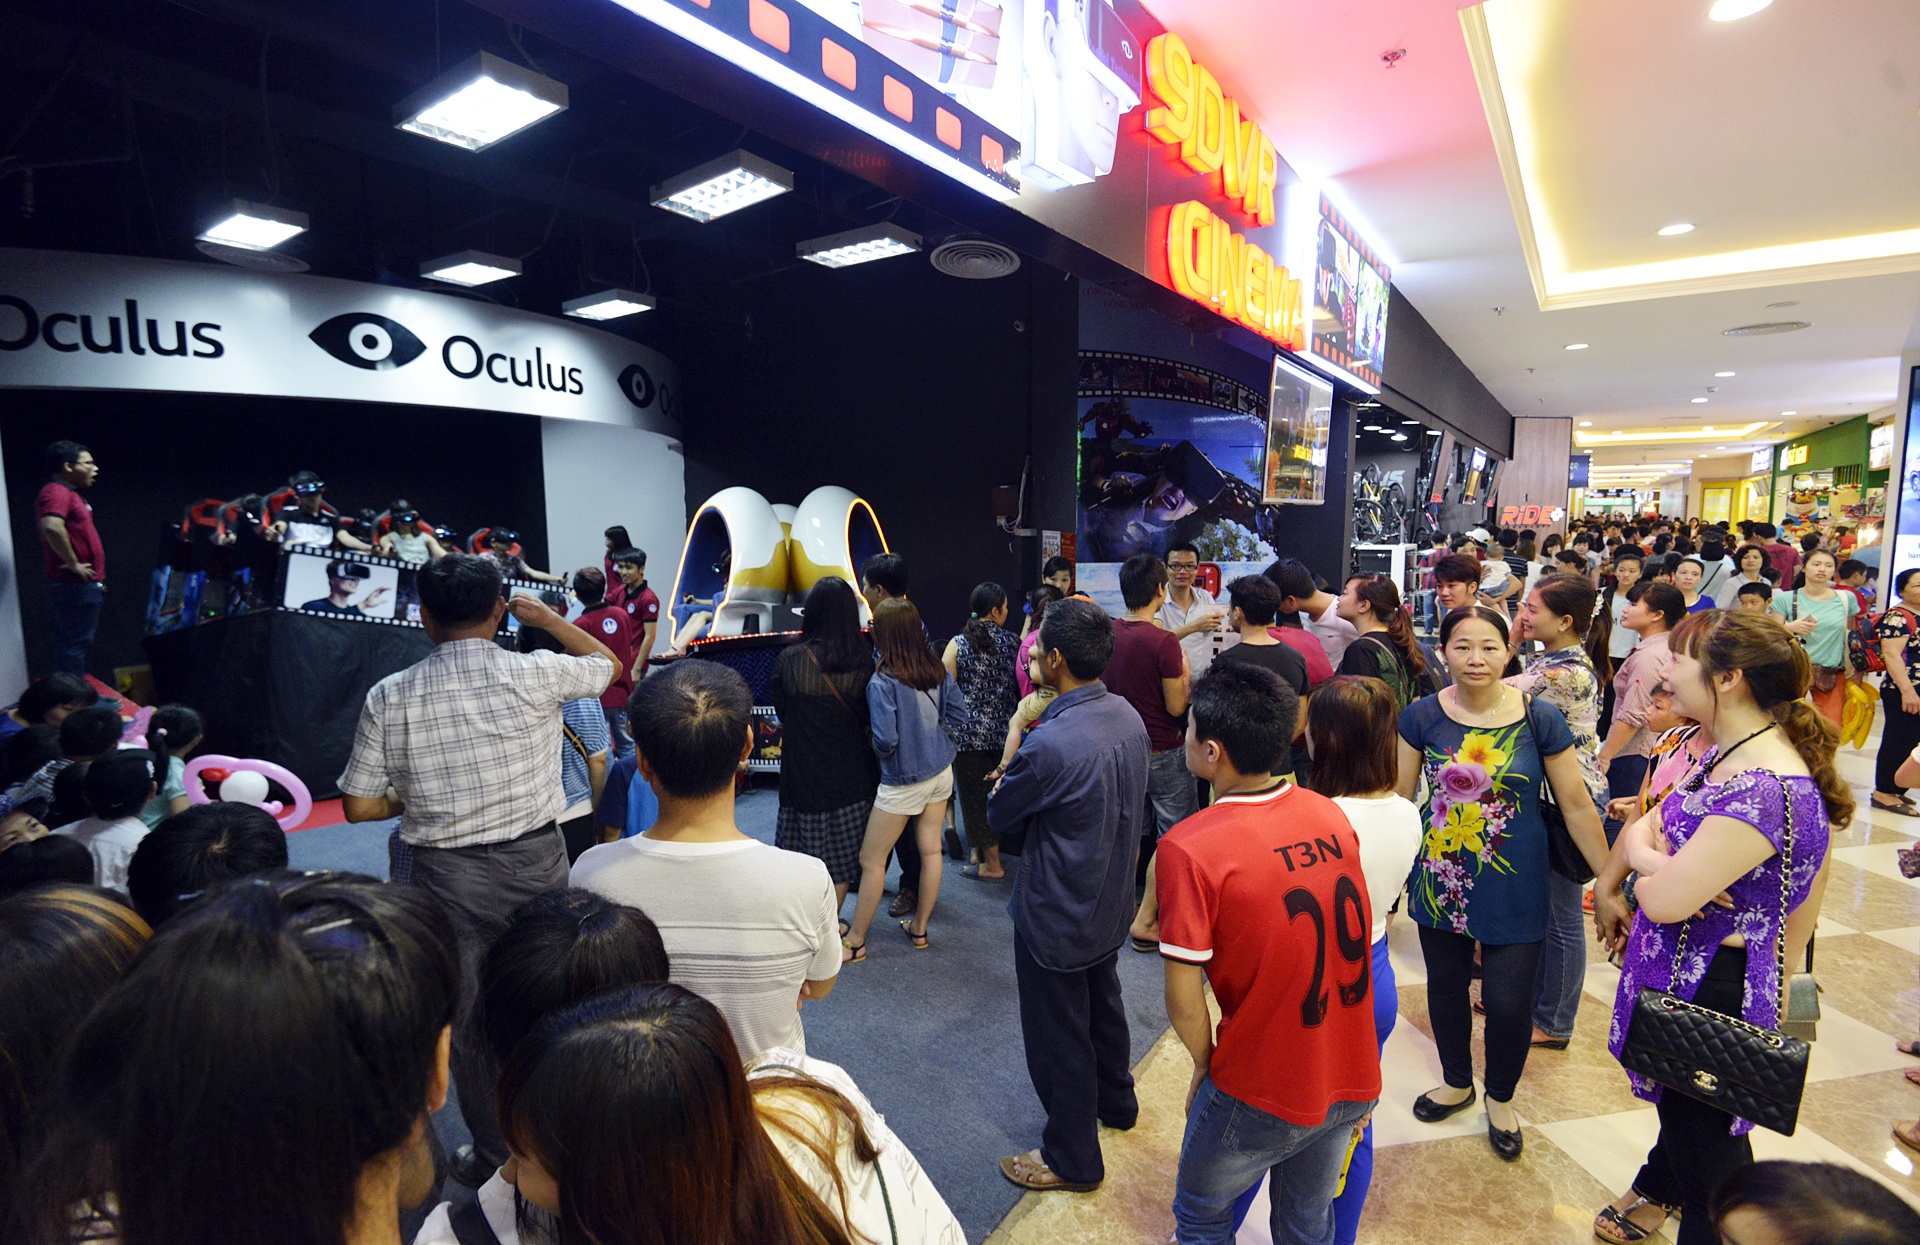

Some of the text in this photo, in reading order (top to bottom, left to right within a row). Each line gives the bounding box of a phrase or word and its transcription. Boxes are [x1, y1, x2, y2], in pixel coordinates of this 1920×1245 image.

[1145, 31, 1278, 227] 9DVR
[0, 294, 225, 359] Oculus
[1166, 199, 1308, 352] CINEMA
[441, 335, 584, 395] Oculus
[1273, 834, 1344, 873] T3N
[1282, 874, 1369, 1028] 29
